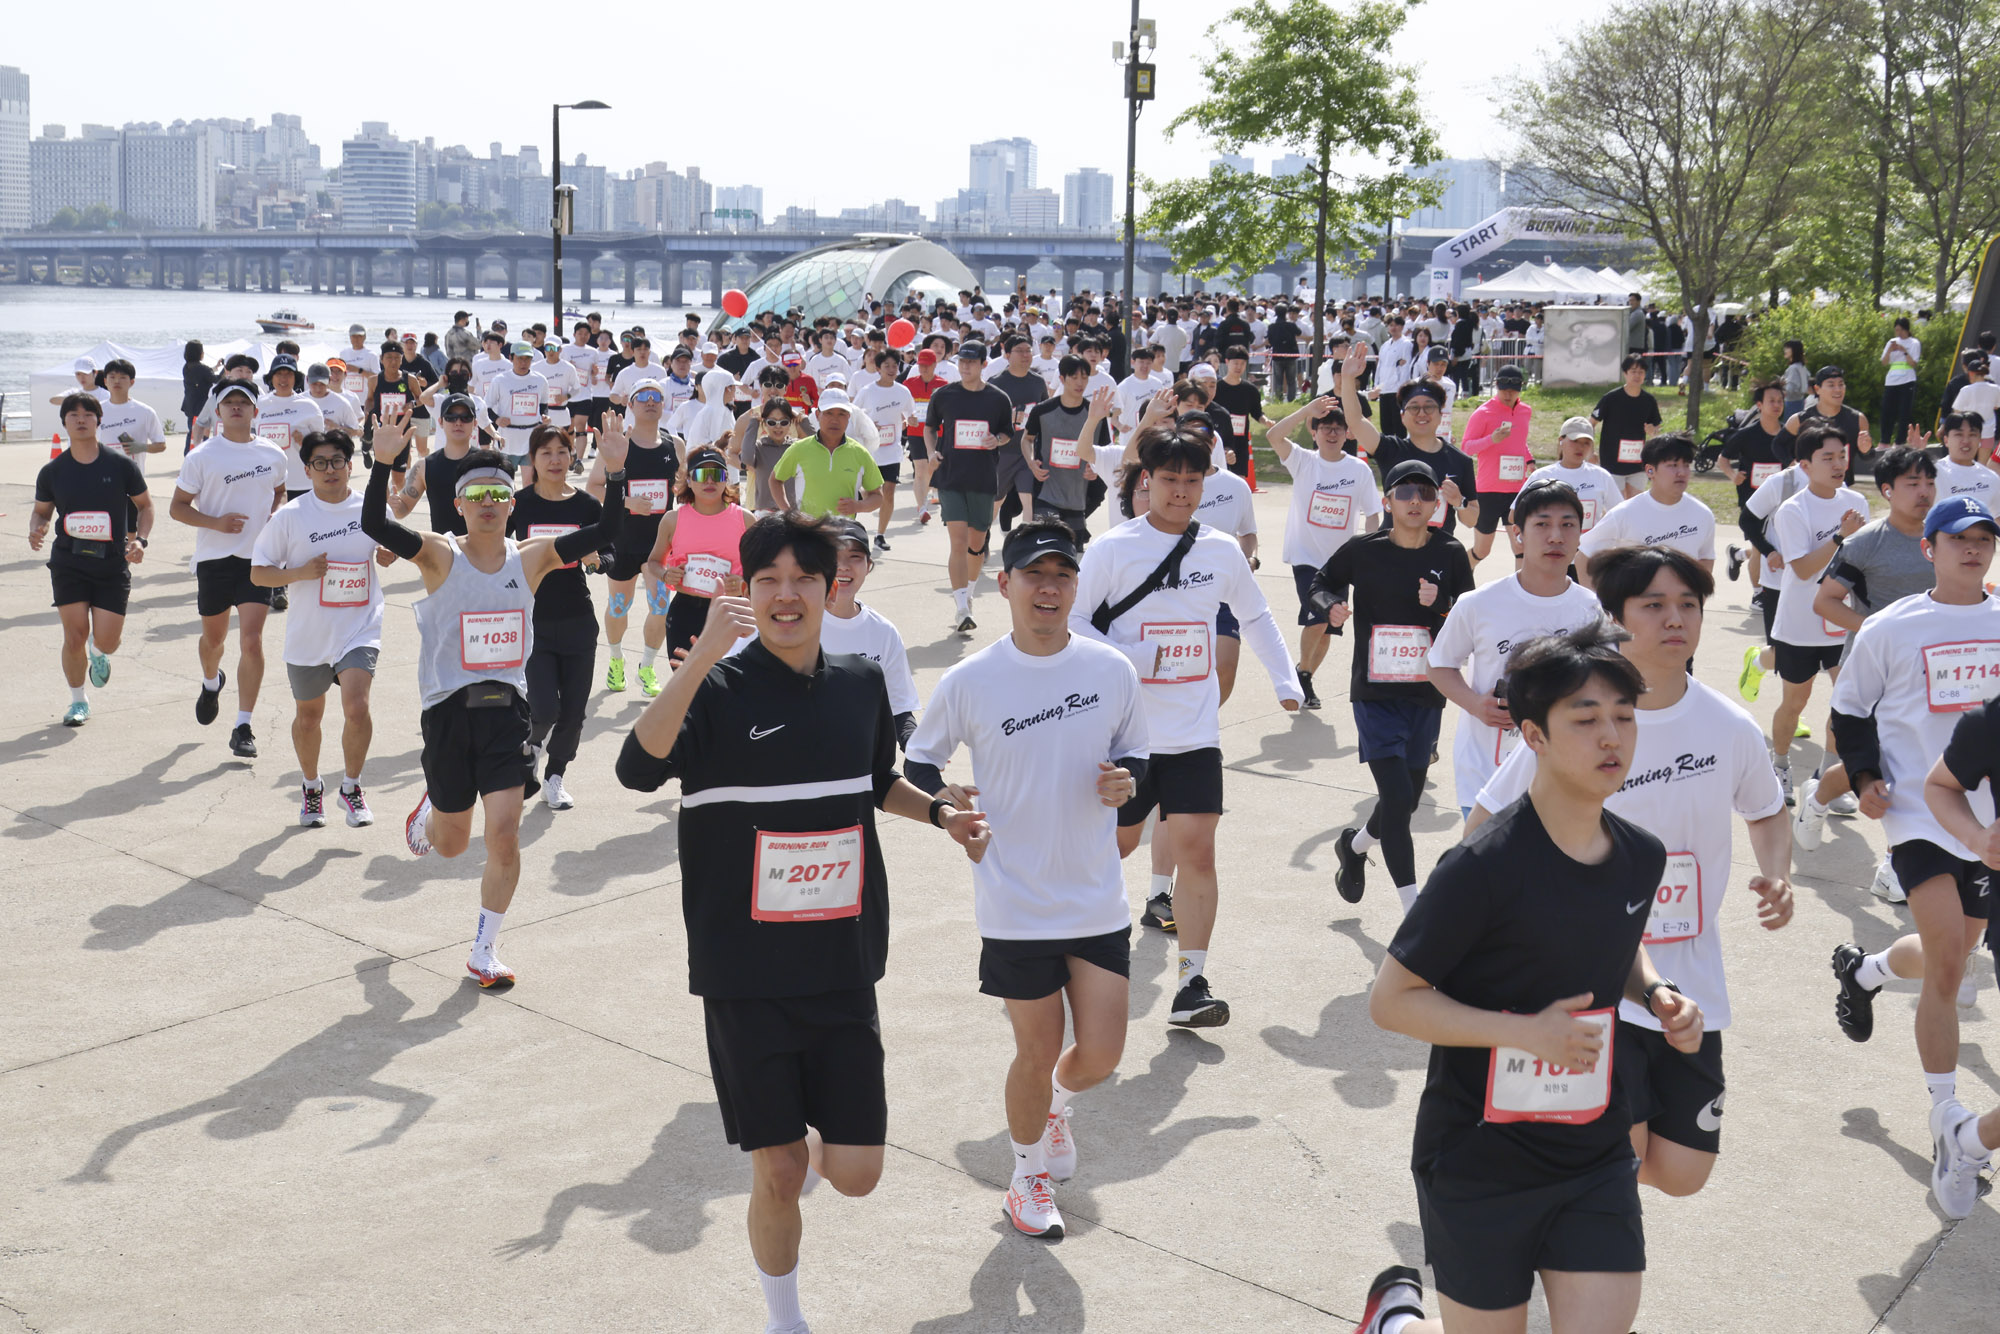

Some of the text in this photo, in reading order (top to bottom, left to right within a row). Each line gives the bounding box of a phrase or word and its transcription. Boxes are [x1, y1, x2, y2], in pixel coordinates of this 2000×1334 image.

[1525, 219, 1594, 234] BURNING
[1449, 222, 1499, 259] START
[223, 465, 272, 484] Burning Run
[1339, 478, 1355, 488] Run
[1975, 482, 1990, 490] Run
[1198, 494, 1234, 510] ning Run
[1962, 498, 1982, 513] LA
[1321, 505, 1345, 517] 2082
[78, 524, 105, 534] 2207
[309, 520, 363, 544] Burning Ru
[1644, 524, 1698, 546] Burning Run
[327, 577, 366, 589] M 1208
[1188, 571, 1215, 584] Run
[469, 631, 518, 645] M 1038
[1147, 628, 1176, 636] BURNING
[1163, 644, 1203, 658] 1819
[1378, 646, 1428, 658] M 1937
[1931, 648, 1963, 657] BURNING
[1936, 662, 2000, 682] M 1714
[1939, 690, 1961, 699] C-88
[1001, 692, 1100, 736] Burning Run
[1616, 765, 1673, 794] urning
[1674, 753, 1718, 774] Run
[767, 842, 809, 851] BURNING
[809, 840, 830, 850] RUN
[837, 837, 857, 847] 10km
[768, 860, 851, 884] M 2077
[1672, 861, 1693, 870] 10km
[799, 886, 821, 897] 유성환
[1662, 921, 1690, 934] E-79
[1506, 1058, 1526, 1074] M
